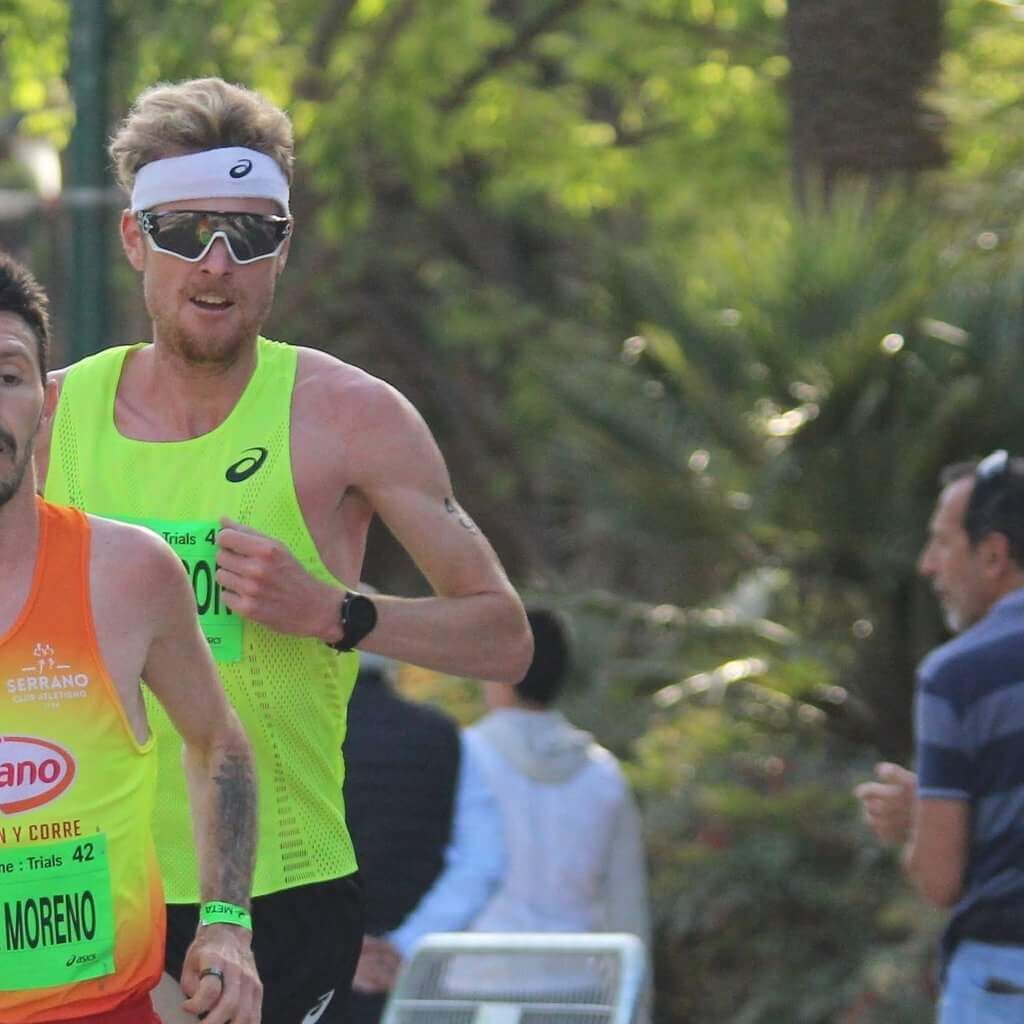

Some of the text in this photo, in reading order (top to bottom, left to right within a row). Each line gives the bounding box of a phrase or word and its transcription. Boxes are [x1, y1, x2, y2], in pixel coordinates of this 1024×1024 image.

[162, 531, 197, 545] Trials
[7, 674, 89, 693] SERRANO
[12, 826, 23, 843] Y
[29, 819, 83, 841] CORRE
[27, 855, 63, 870] Trials
[72, 843, 95, 863] 42
[205, 904, 233, 914] META
[4, 890, 96, 951] MORENO
